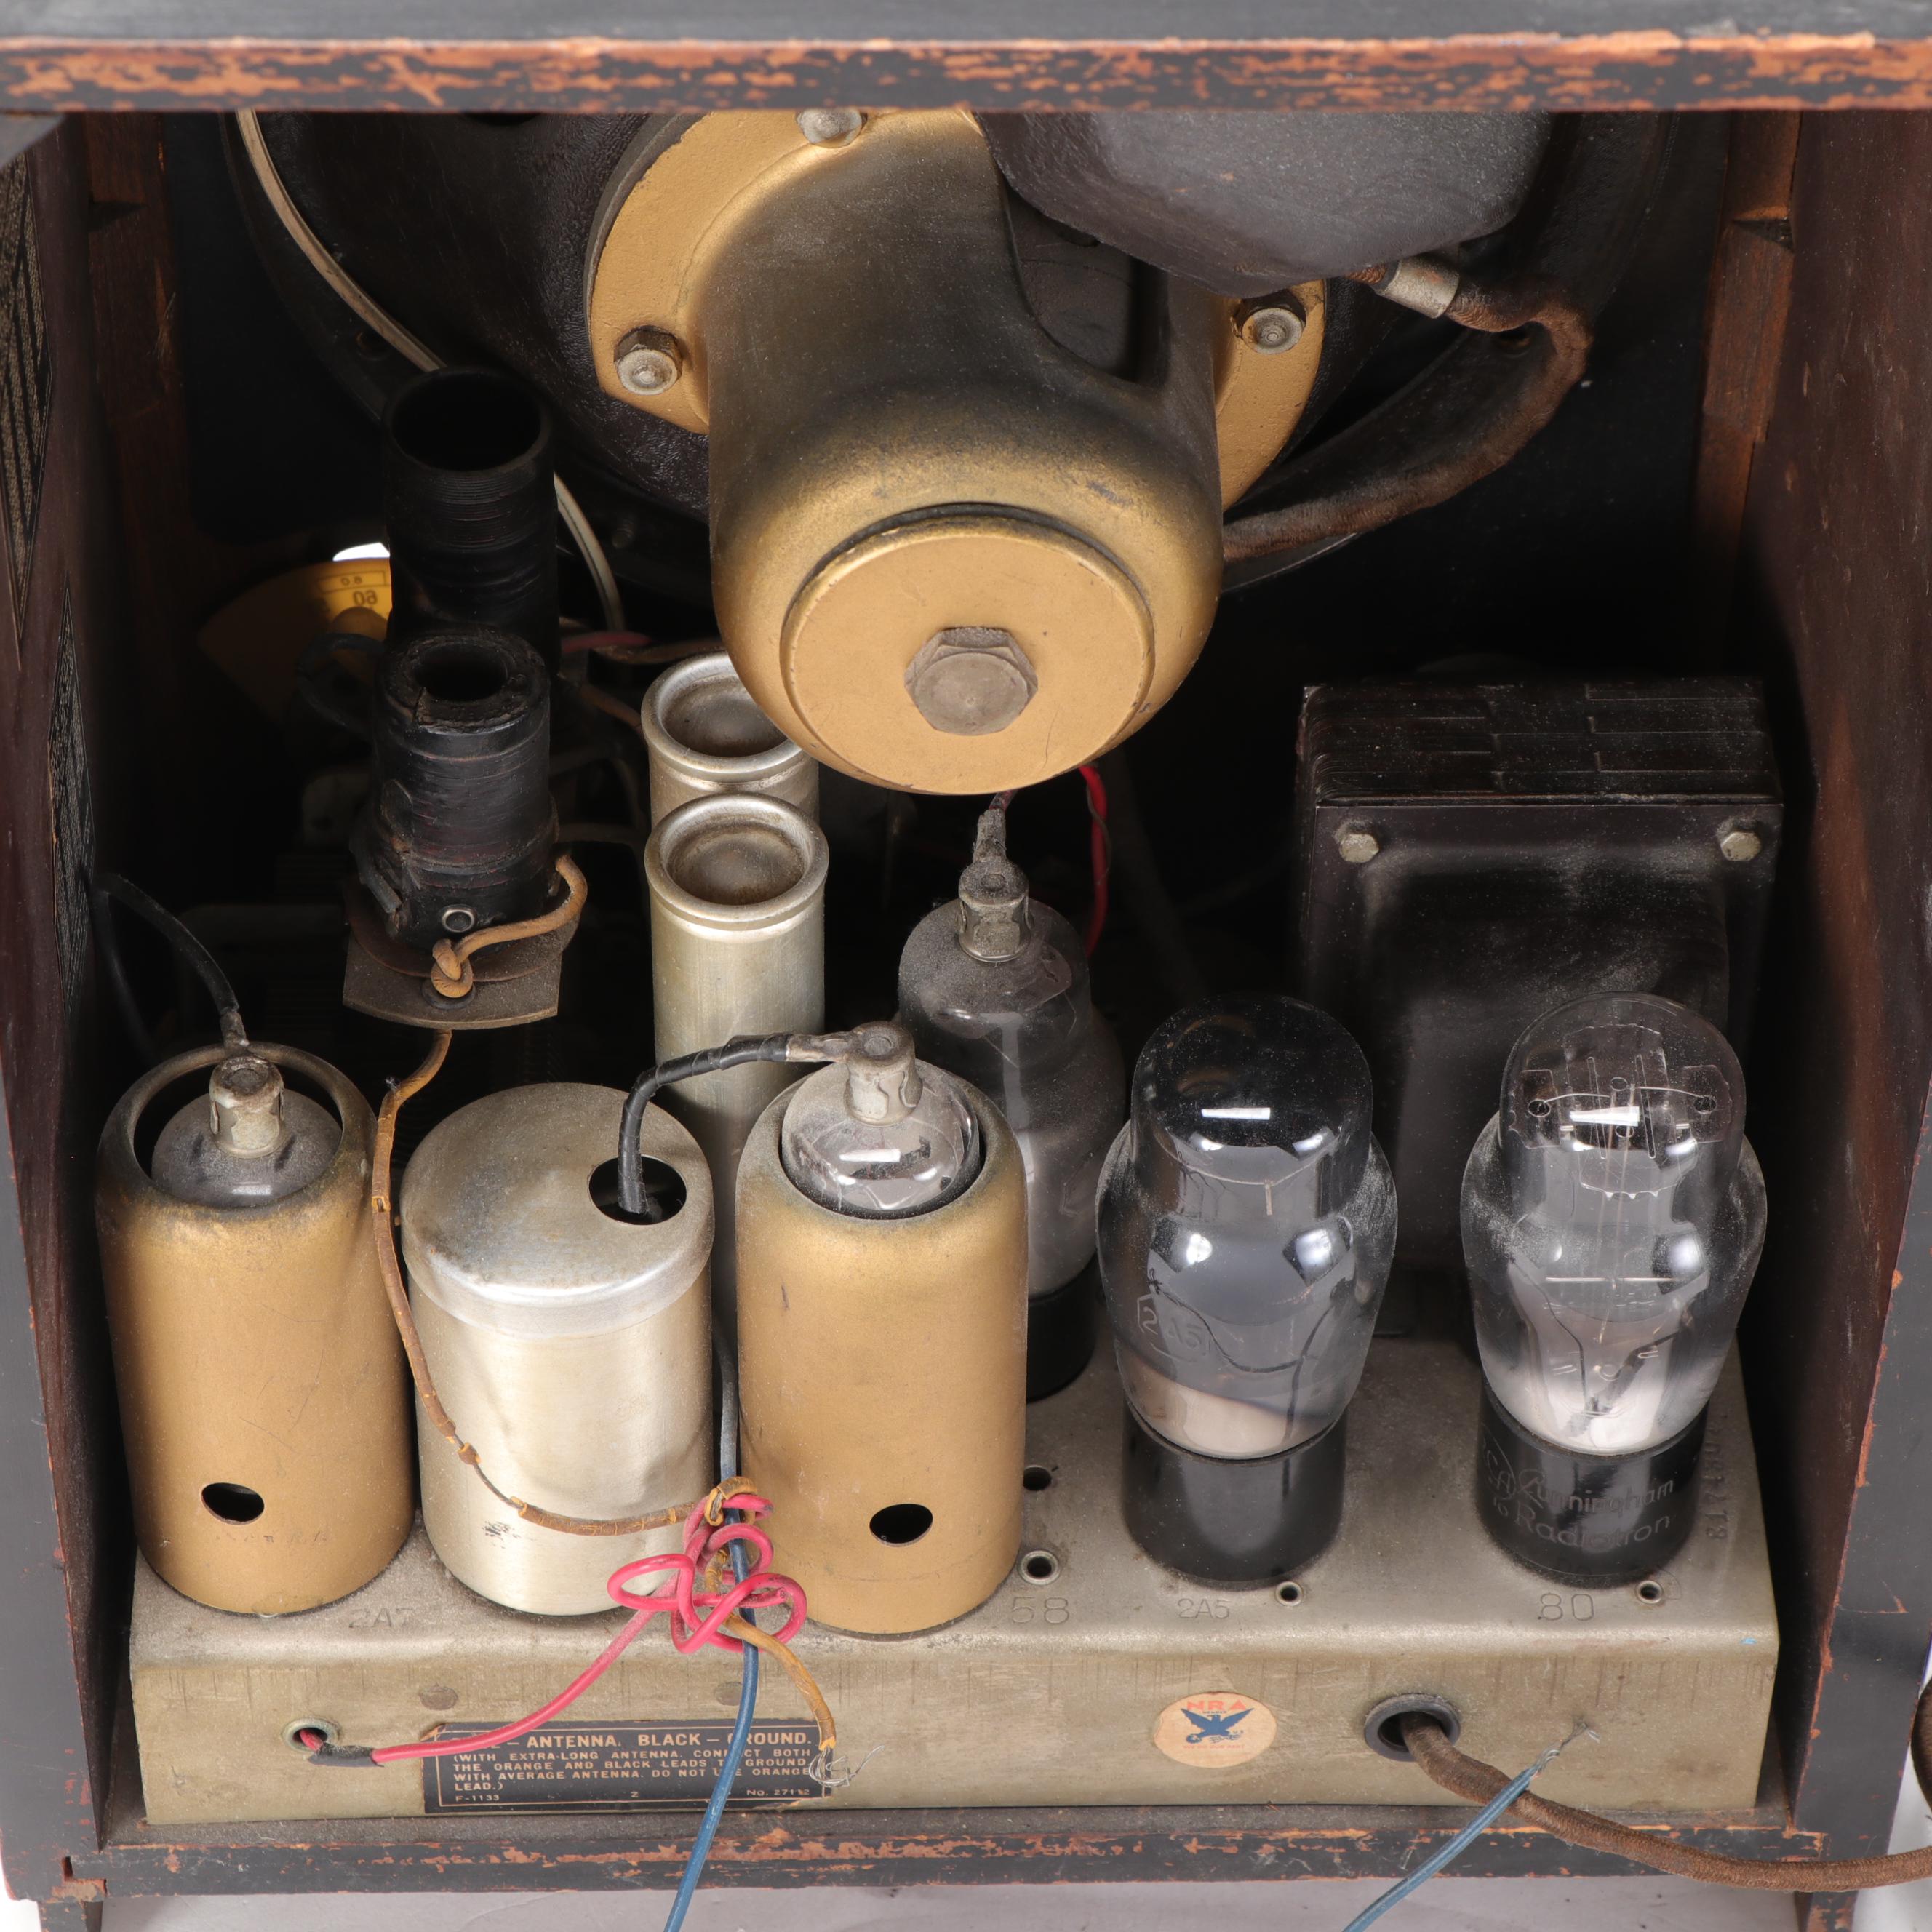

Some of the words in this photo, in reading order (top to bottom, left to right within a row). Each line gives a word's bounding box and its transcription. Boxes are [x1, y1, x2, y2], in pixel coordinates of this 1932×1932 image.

[1514, 1503, 1672, 1550] Radiotron
[1010, 1596, 1070, 1625] 58
[1176, 1597, 1230, 1620] 2A5
[1540, 1592, 1595, 1621] 80
[1186, 1699, 1247, 1711] NRA
[527, 1734, 622, 1749] ANTENNA.
[638, 1732, 701, 1747] BLACK
[454, 1753, 497, 1763] (WITH
[509, 1751, 599, 1762] EXTRA-LONG
[611, 1749, 682, 1760] ANTENNA.
[693, 1749, 761, 1758] CONCT
[773, 1748, 811, 1757] BOTH
[453, 1763, 482, 1772] THE
[494, 1762, 554, 1771] ORANGE
[564, 1761, 594, 1770] AND
[604, 1760, 650, 1769] BLACK
[660, 1759, 707, 1768] LEADS
[453, 1773, 490, 1781] WITH
[498, 1771, 565, 1781] AVERAGE
[572, 1769, 644, 1779] ANTENNA.
[652, 1768, 671, 1778] DO
[679, 1768, 706, 1777] NOT
[713, 1768, 743, 1776] UE
[752, 1767, 810, 1776] ORANGE
[454, 1781, 504, 1792] LEAD.)
[455, 1794, 500, 1803] F-1133
